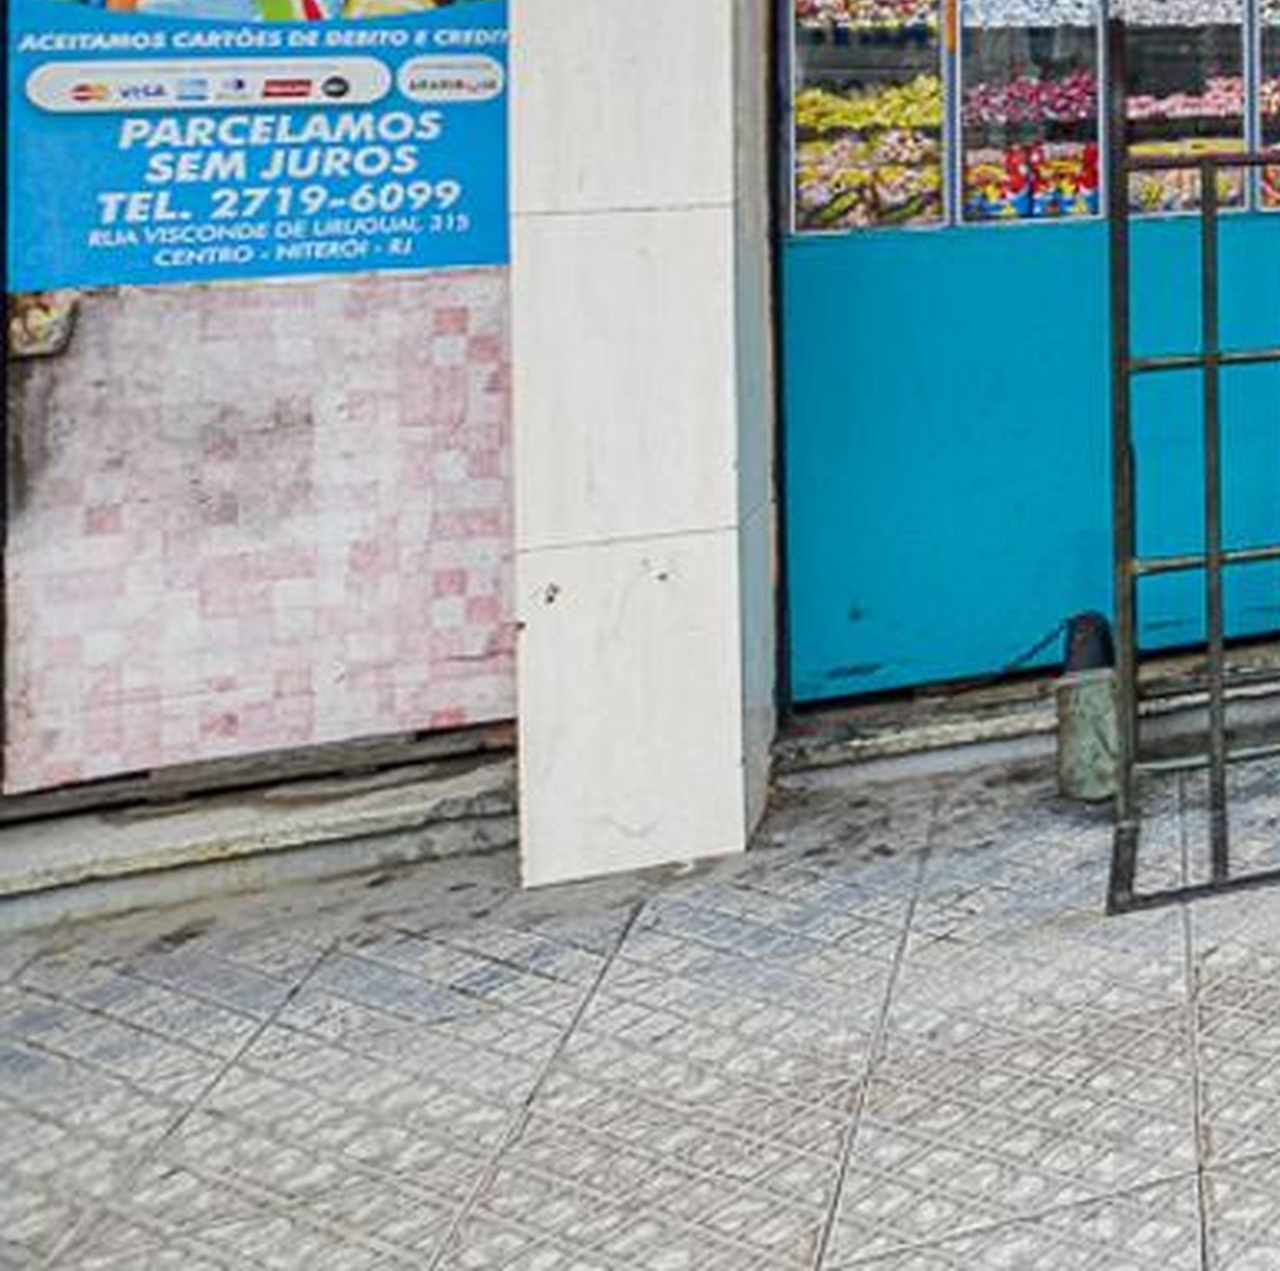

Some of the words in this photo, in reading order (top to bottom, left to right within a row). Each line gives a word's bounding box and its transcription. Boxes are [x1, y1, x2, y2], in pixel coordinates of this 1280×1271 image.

[19, 32, 166, 52] ACEITAMOS
[287, 29, 319, 47] DE
[118, 110, 444, 150] PARCELAMOS
[144, 150, 247, 184] SEM
[261, 144, 419, 180] JUROS
[97, 190, 192, 225] TEL.
[211, 180, 461, 220] 2719-6099
[87, 228, 139, 247] RUA
[144, 222, 267, 245] VISCONDE
[274, 220, 308, 240] DE
[154, 244, 253, 267] CENTRO
